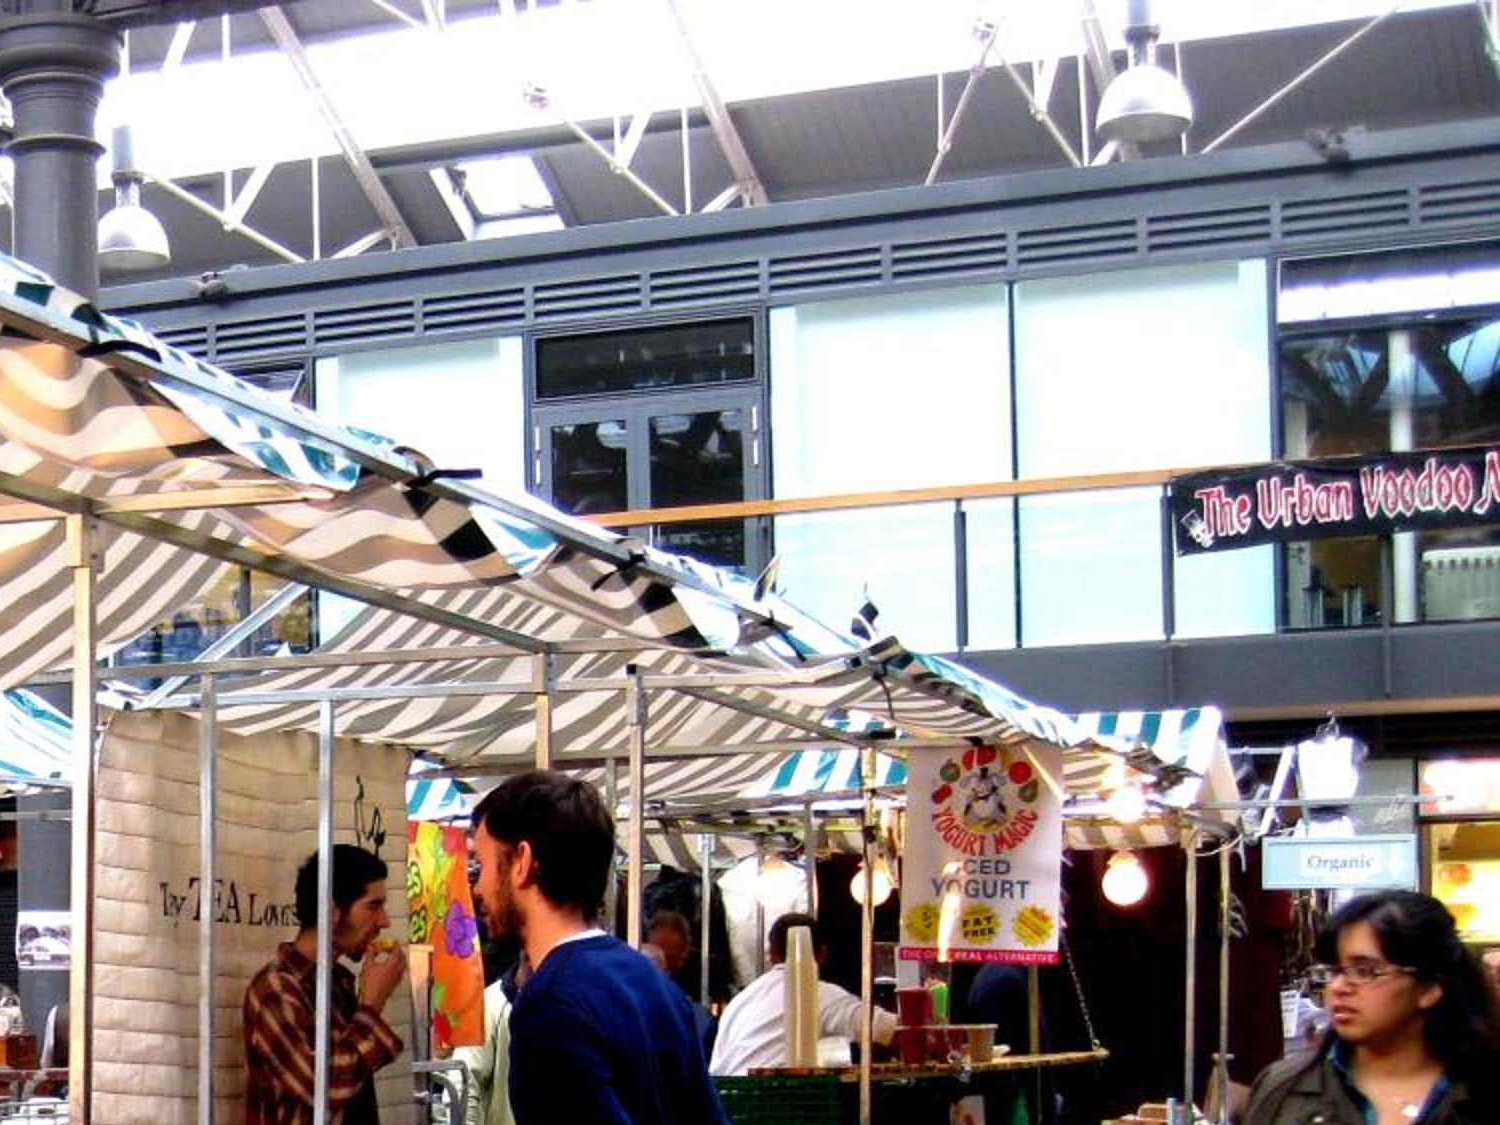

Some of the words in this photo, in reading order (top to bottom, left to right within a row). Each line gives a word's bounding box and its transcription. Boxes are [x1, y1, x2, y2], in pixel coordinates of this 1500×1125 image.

[1194, 485, 1251, 537] The
[1257, 473, 1352, 529] Urban
[1360, 457, 1473, 519] Voodoo
[932, 805, 987, 857] YOGURT
[994, 809, 1038, 855] MAGIC
[962, 858, 1011, 876] CED
[1307, 854, 1375, 872] Organic
[963, 915, 994, 929] FAT
[963, 927, 997, 938] FREE
